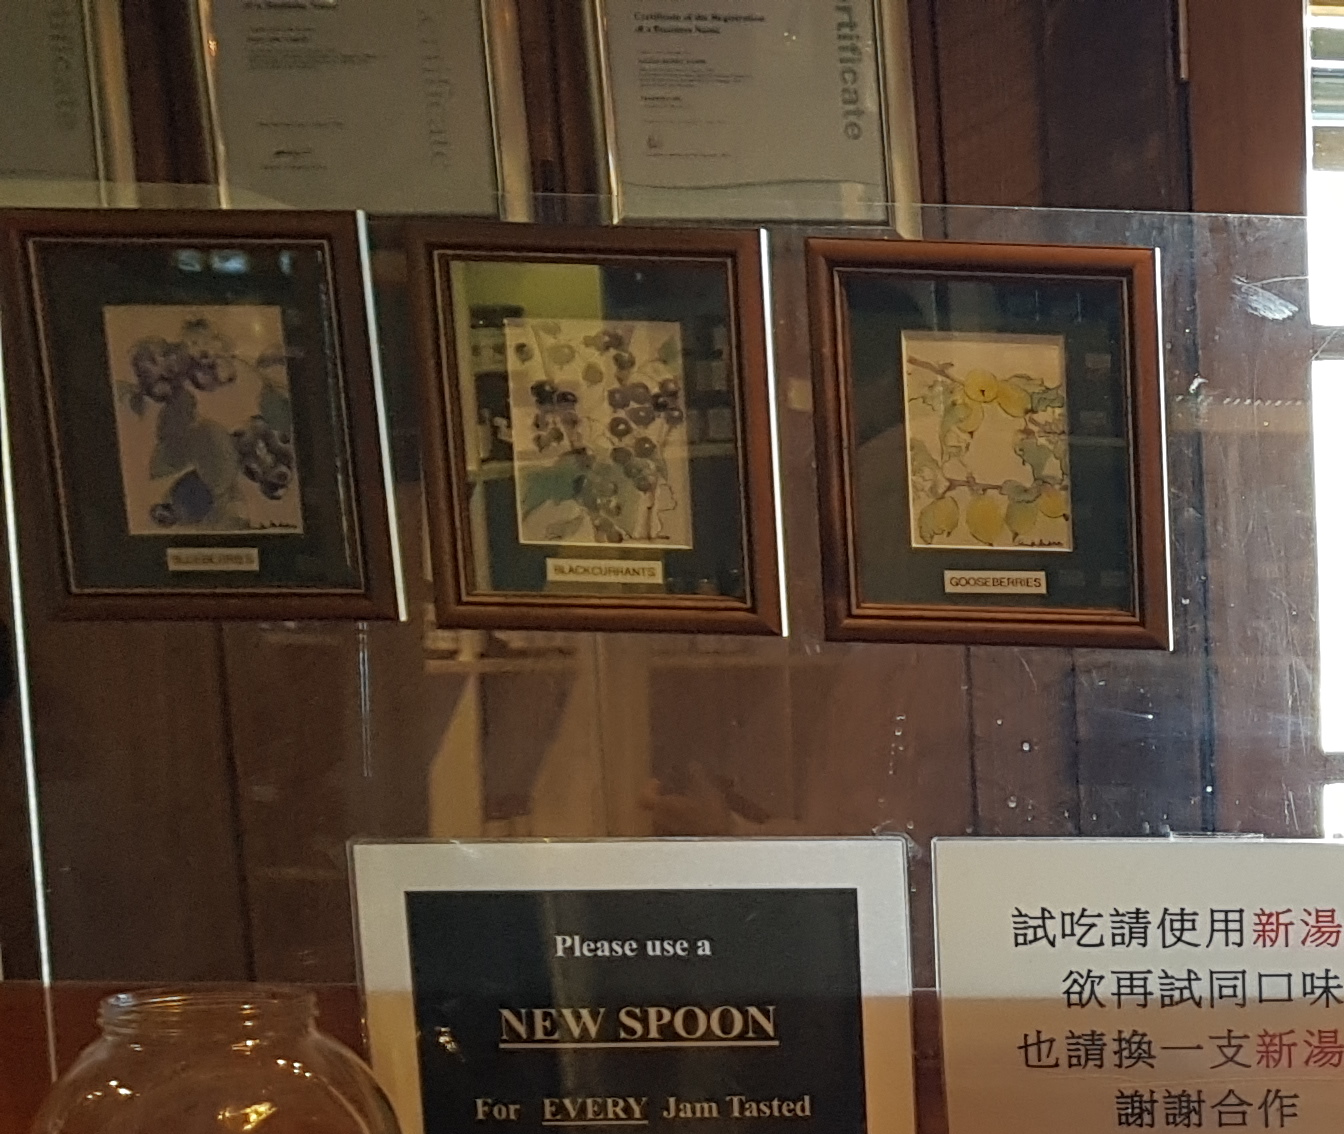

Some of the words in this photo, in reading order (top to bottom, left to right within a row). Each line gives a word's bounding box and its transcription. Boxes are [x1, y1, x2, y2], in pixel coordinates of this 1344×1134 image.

[835, 0, 865, 140] rtificate
[949, 576, 1042, 588] GOOSEBERRIES
[554, 935, 638, 957] Please
[646, 938, 688, 957] use
[697, 940, 712, 957] a
[1061, 968, 1344, 1010] 欲再試同口味
[500, 1008, 607, 1041] NEW
[618, 1005, 777, 1040] SPOON
[475, 1098, 520, 1121] For
[542, 1098, 648, 1121] EVERY
[663, 1097, 719, 1119] Jam
[725, 1095, 812, 1118] Tasted
[1115, 1089, 1300, 1129] 謝謝合作
